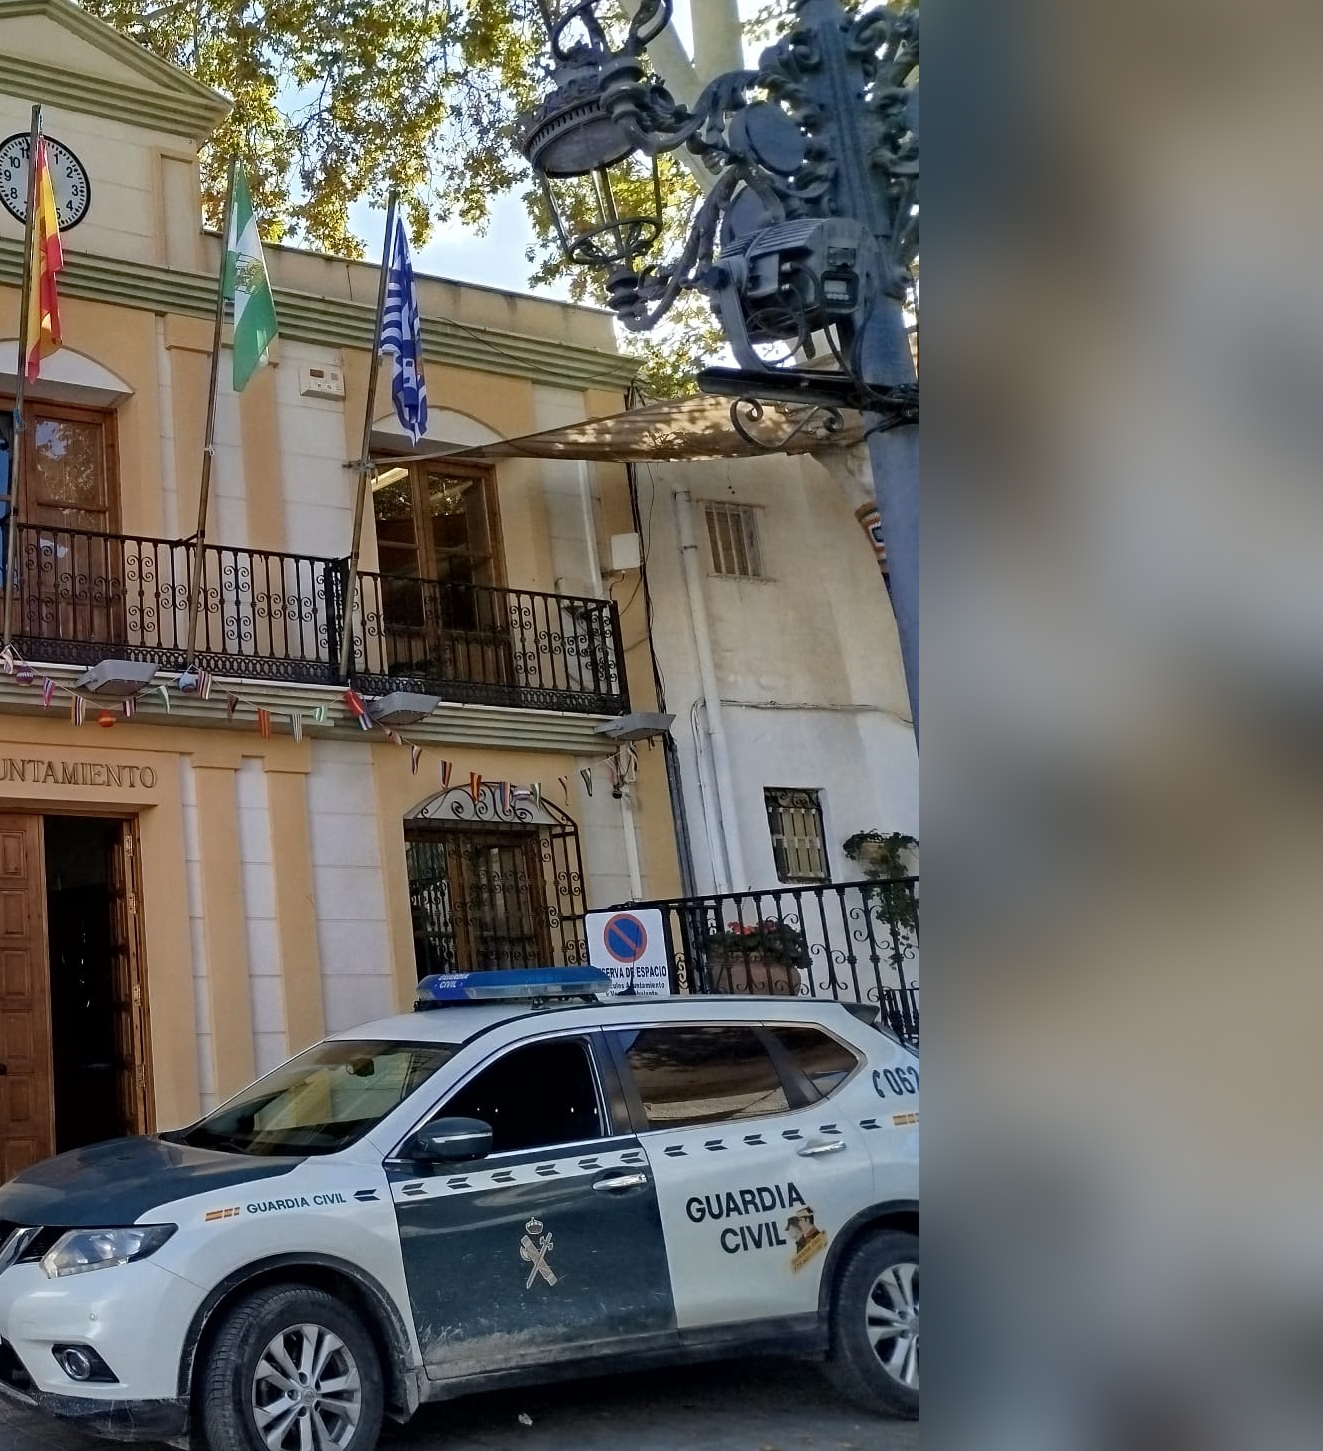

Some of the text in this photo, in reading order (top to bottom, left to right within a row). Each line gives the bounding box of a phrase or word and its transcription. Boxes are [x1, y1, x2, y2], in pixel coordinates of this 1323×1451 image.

[9, 156, 21, 169] 10
[54, 153, 59, 165] 1
[4, 169, 12, 181] 9
[66, 166, 74, 178] 2
[10, 187, 18, 199] 8
[71, 184, 79, 197] 3
[65, 200, 73, 211] 4
[636, 965, 667, 977] ESPACIO
[246, 1192, 347, 1214] GUARDIA CIVIL
[685, 1181, 806, 1223] GUARDIA
[720, 1221, 787, 1254] CIVIL
